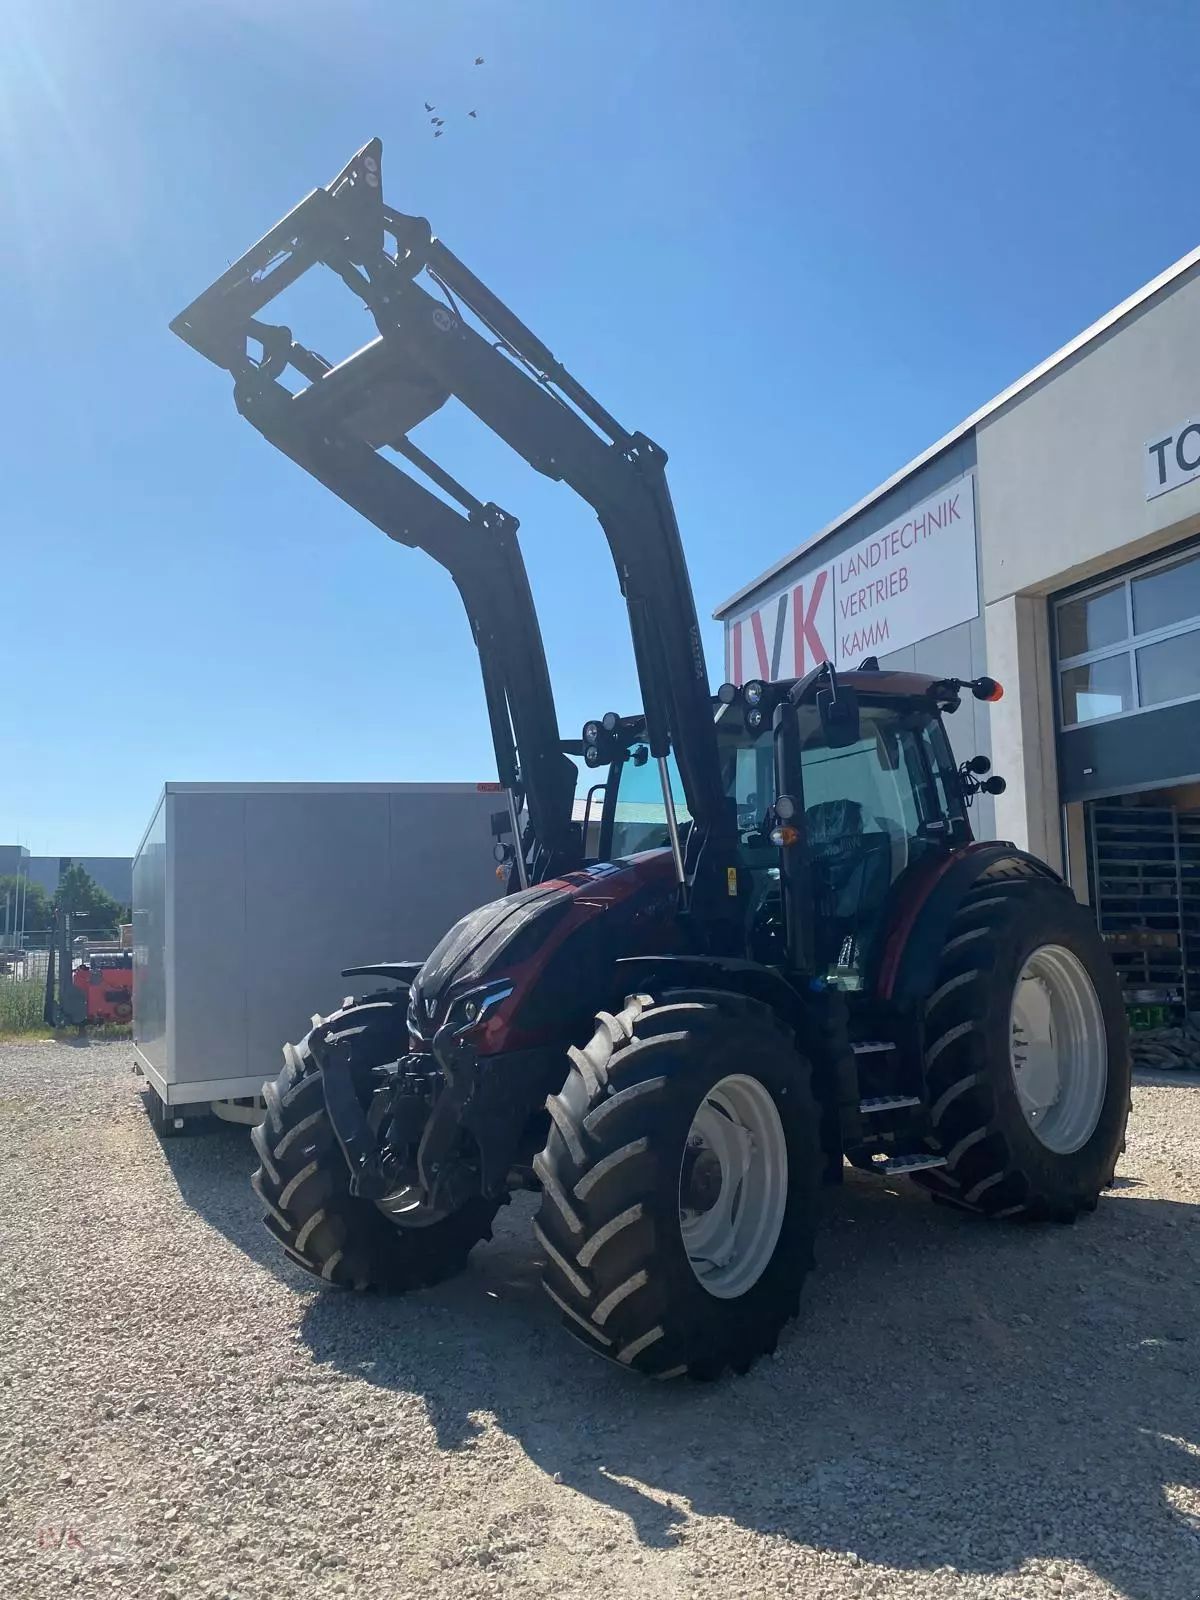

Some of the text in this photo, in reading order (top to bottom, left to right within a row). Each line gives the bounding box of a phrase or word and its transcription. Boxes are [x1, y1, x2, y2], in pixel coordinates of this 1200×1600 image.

[840, 494, 961, 585] LANDTECHNIK
[840, 567, 909, 620] VERTRIEB
[842, 618, 890, 659] KAMM
